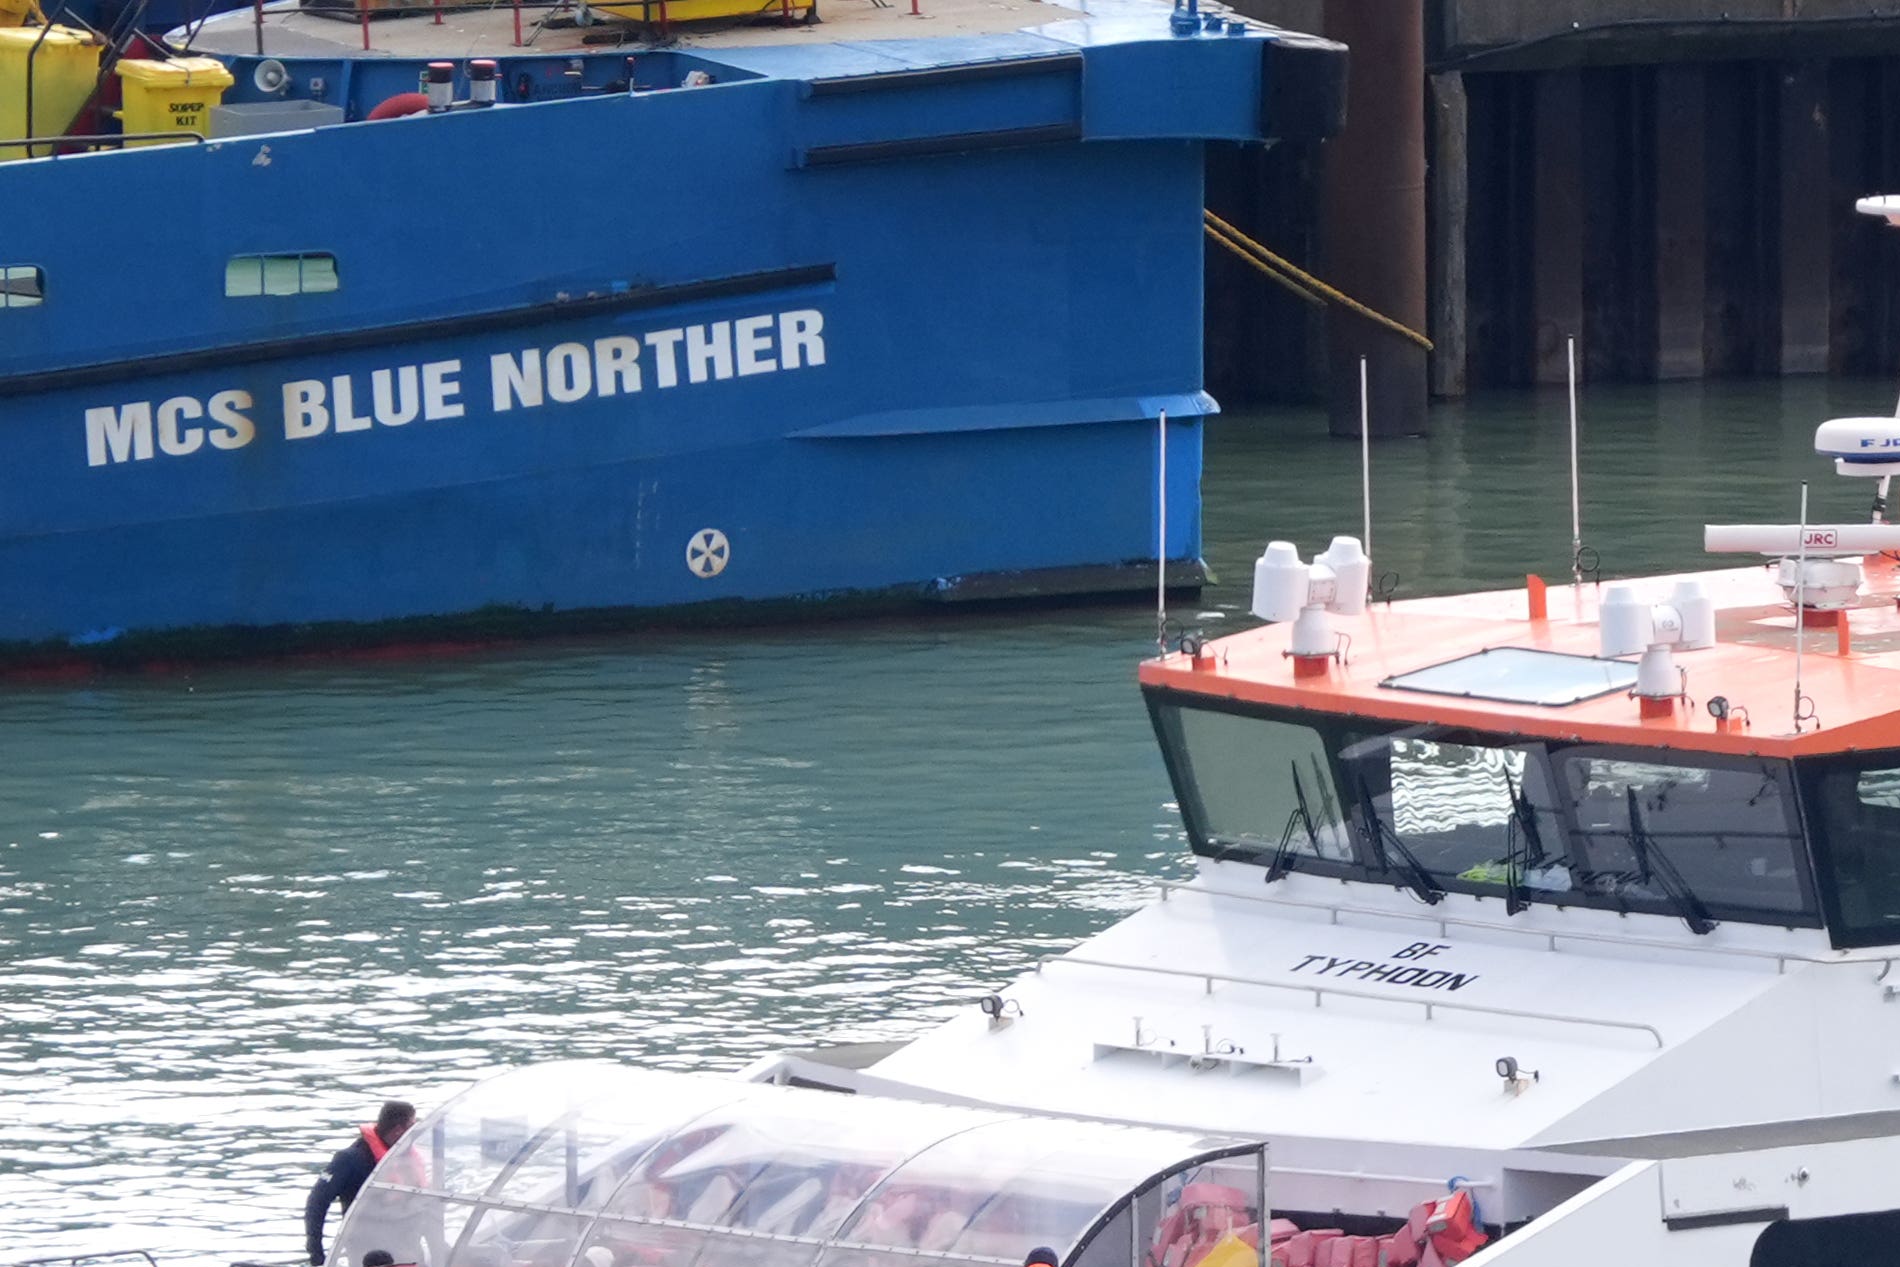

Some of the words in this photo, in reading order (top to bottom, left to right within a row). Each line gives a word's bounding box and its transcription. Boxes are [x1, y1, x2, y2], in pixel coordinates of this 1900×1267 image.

[176, 116, 197, 125] KIT
[85, 389, 256, 467] MCS
[282, 359, 465, 440] BLUE
[490, 309, 826, 412] NORTHER
[1804, 533, 1834, 545] JRC
[1391, 942, 1453, 961] BF
[1290, 955, 1479, 991] TYPHOON
